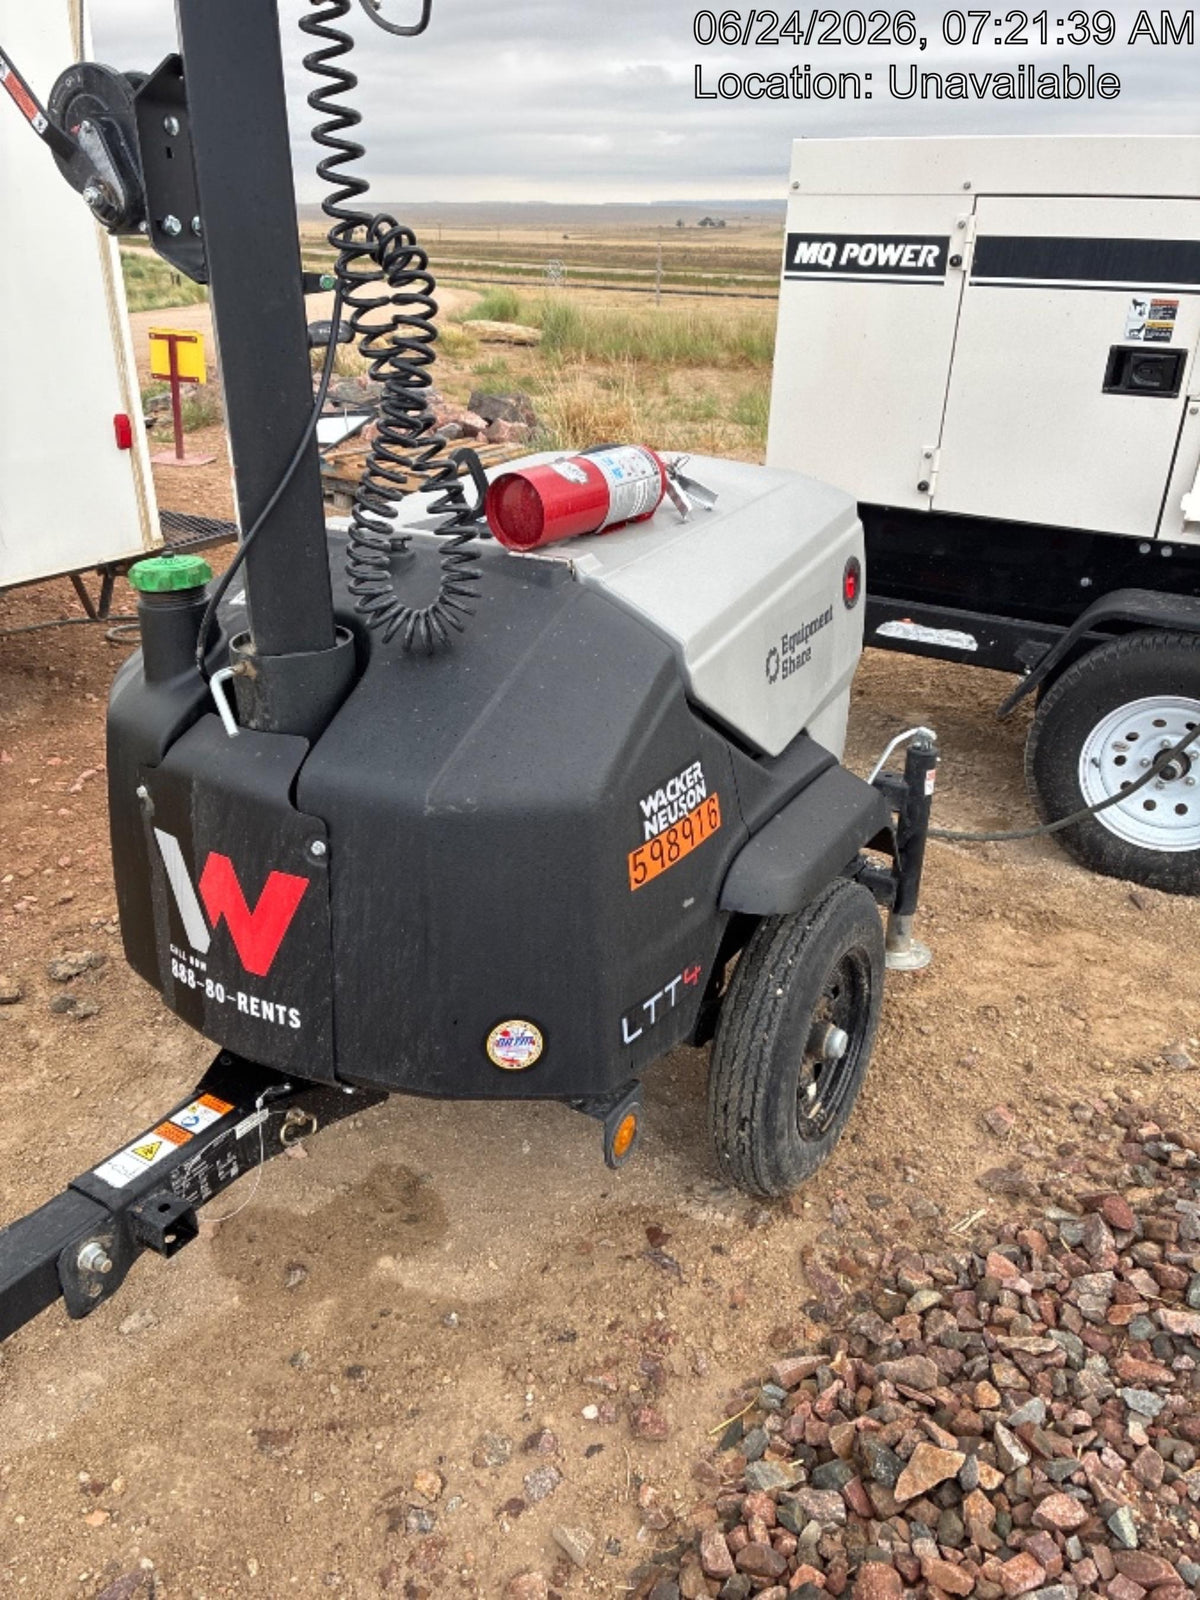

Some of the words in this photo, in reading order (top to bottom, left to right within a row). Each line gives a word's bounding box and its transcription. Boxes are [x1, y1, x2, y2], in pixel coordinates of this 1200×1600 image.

[793, 241, 837, 269] MQ
[839, 243, 940, 268] POWER
[781, 603, 833, 656] Equipment
[781, 646, 812, 680] Share
[640, 760, 704, 818] WACKER
[643, 779, 707, 841] NEUSON
[632, 797, 718, 885] 598916
[171, 957, 302, 1029] 888-80-RENTS
[621, 963, 702, 1045] LTT4
